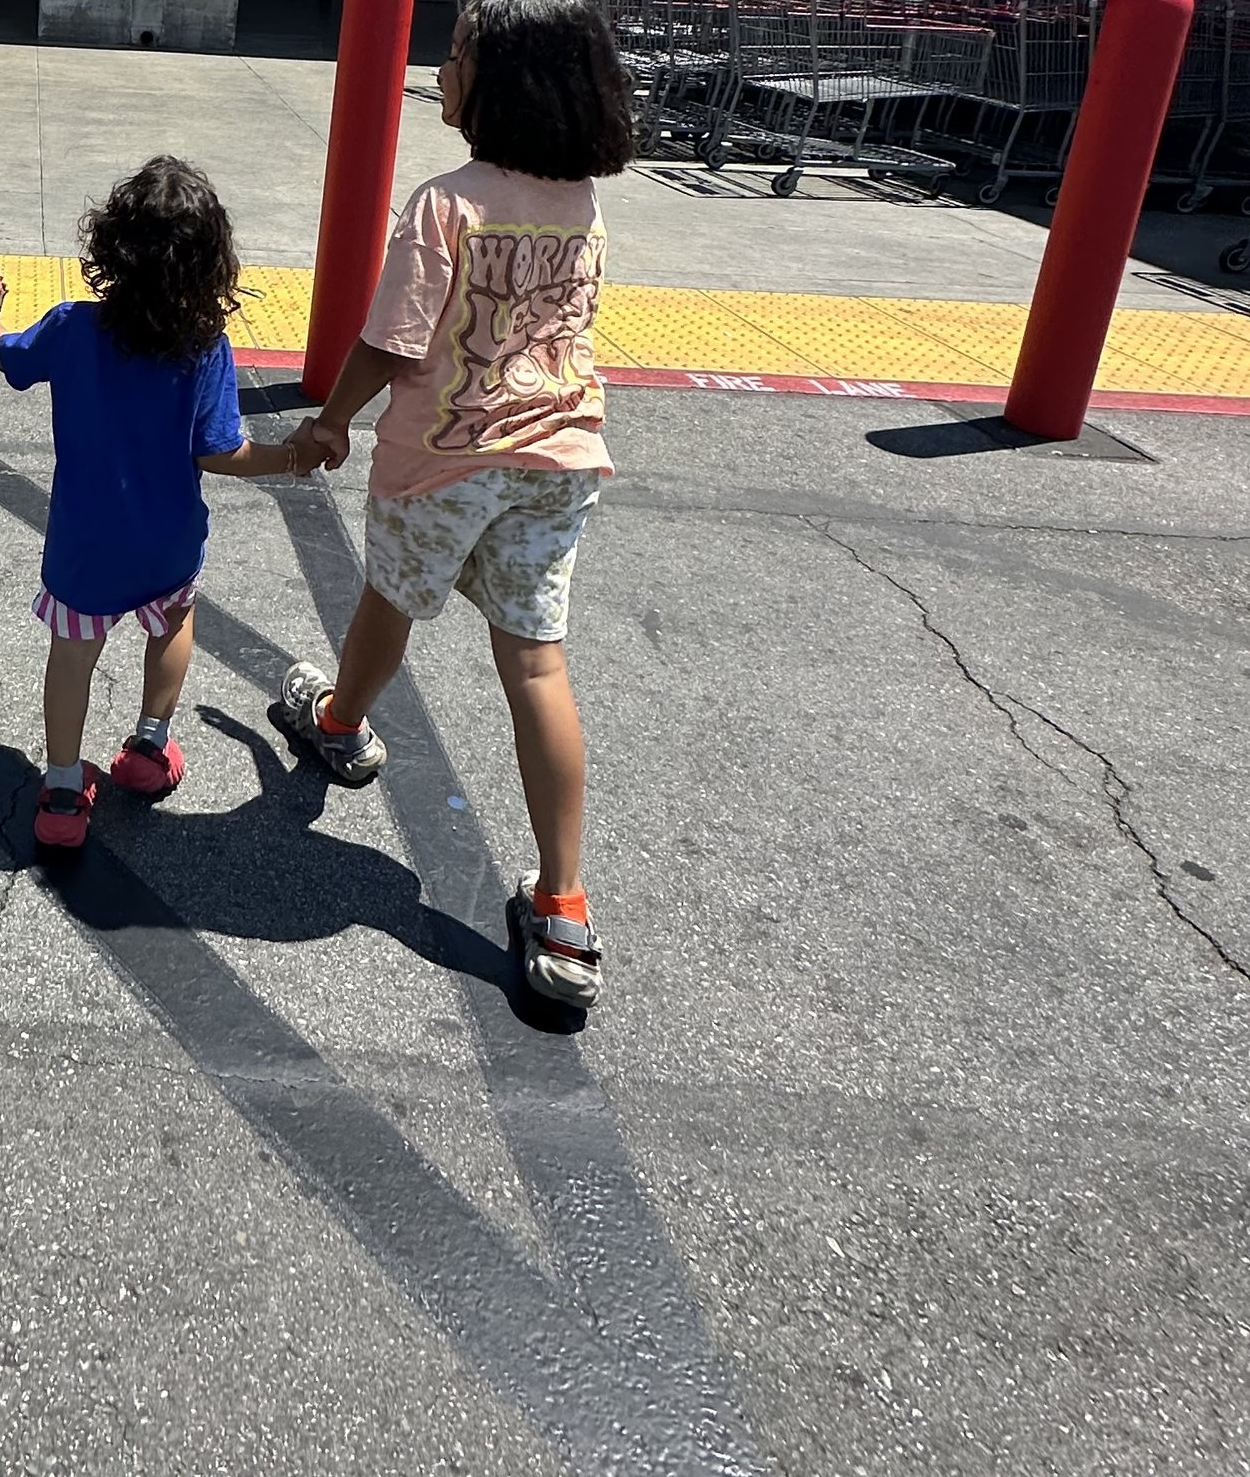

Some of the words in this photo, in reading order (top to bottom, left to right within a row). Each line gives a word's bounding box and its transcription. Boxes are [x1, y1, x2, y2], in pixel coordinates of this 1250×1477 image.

[466, 233, 606, 301] WORRY
[459, 280, 602, 365] LESS
[685, 372, 776, 392] FIRE
[808, 379, 919, 398] LANE
